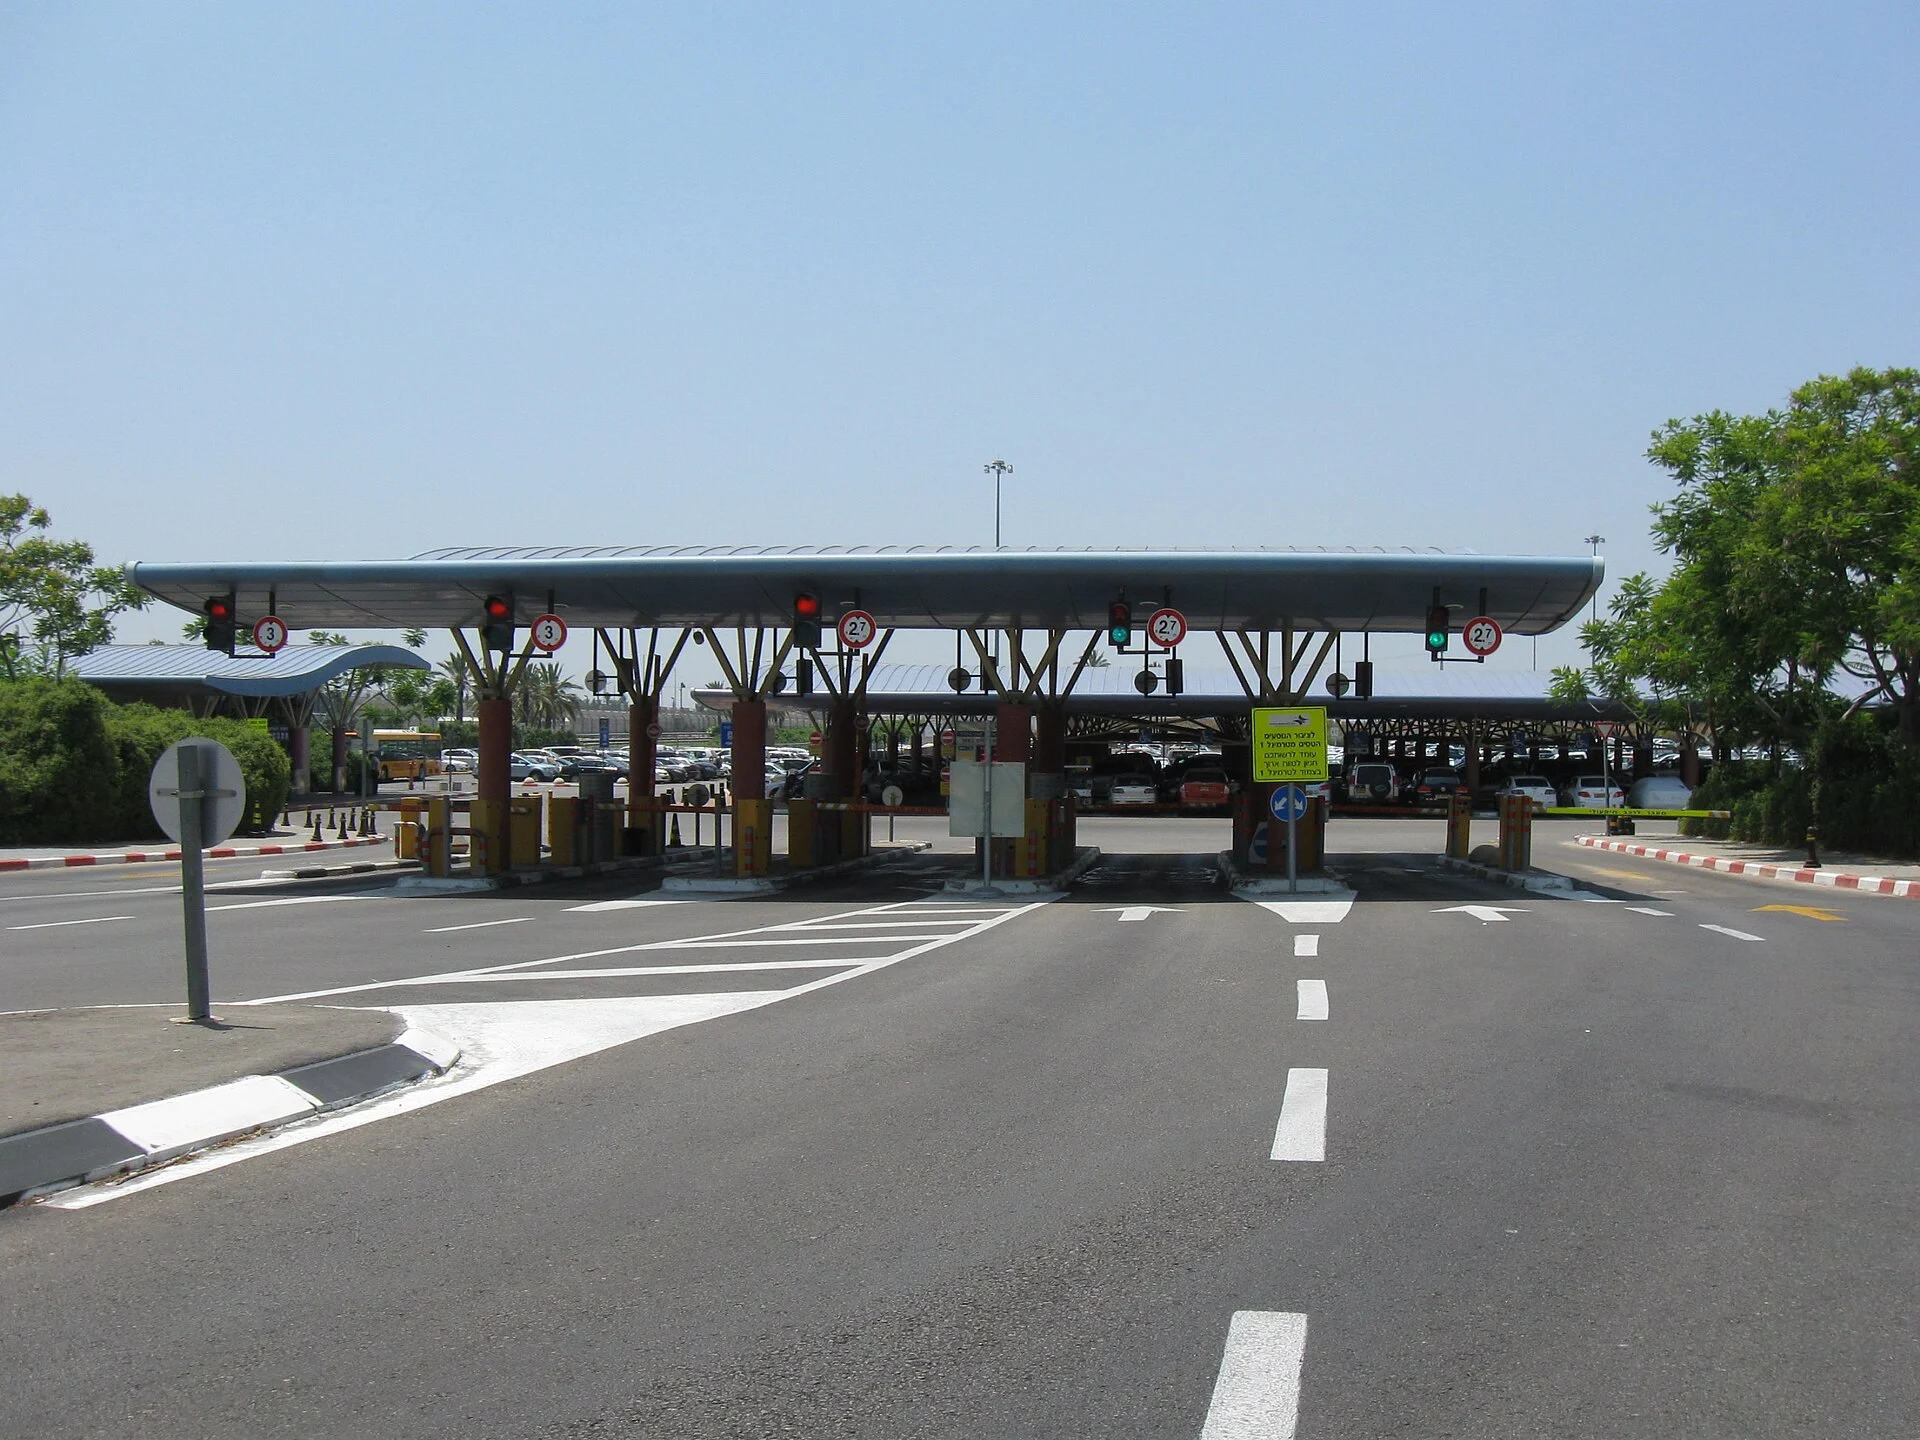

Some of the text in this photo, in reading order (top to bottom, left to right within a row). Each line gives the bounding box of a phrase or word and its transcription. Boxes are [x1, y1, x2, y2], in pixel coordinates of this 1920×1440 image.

[266, 627, 275, 640] 3
[545, 625, 553, 639] 3
[849, 621, 866, 635] 2.7
[1159, 620, 1177, 634] 2.7
[1474, 628, 1492, 642] 2.7
[1294, 731, 1315, 739] לציבור
